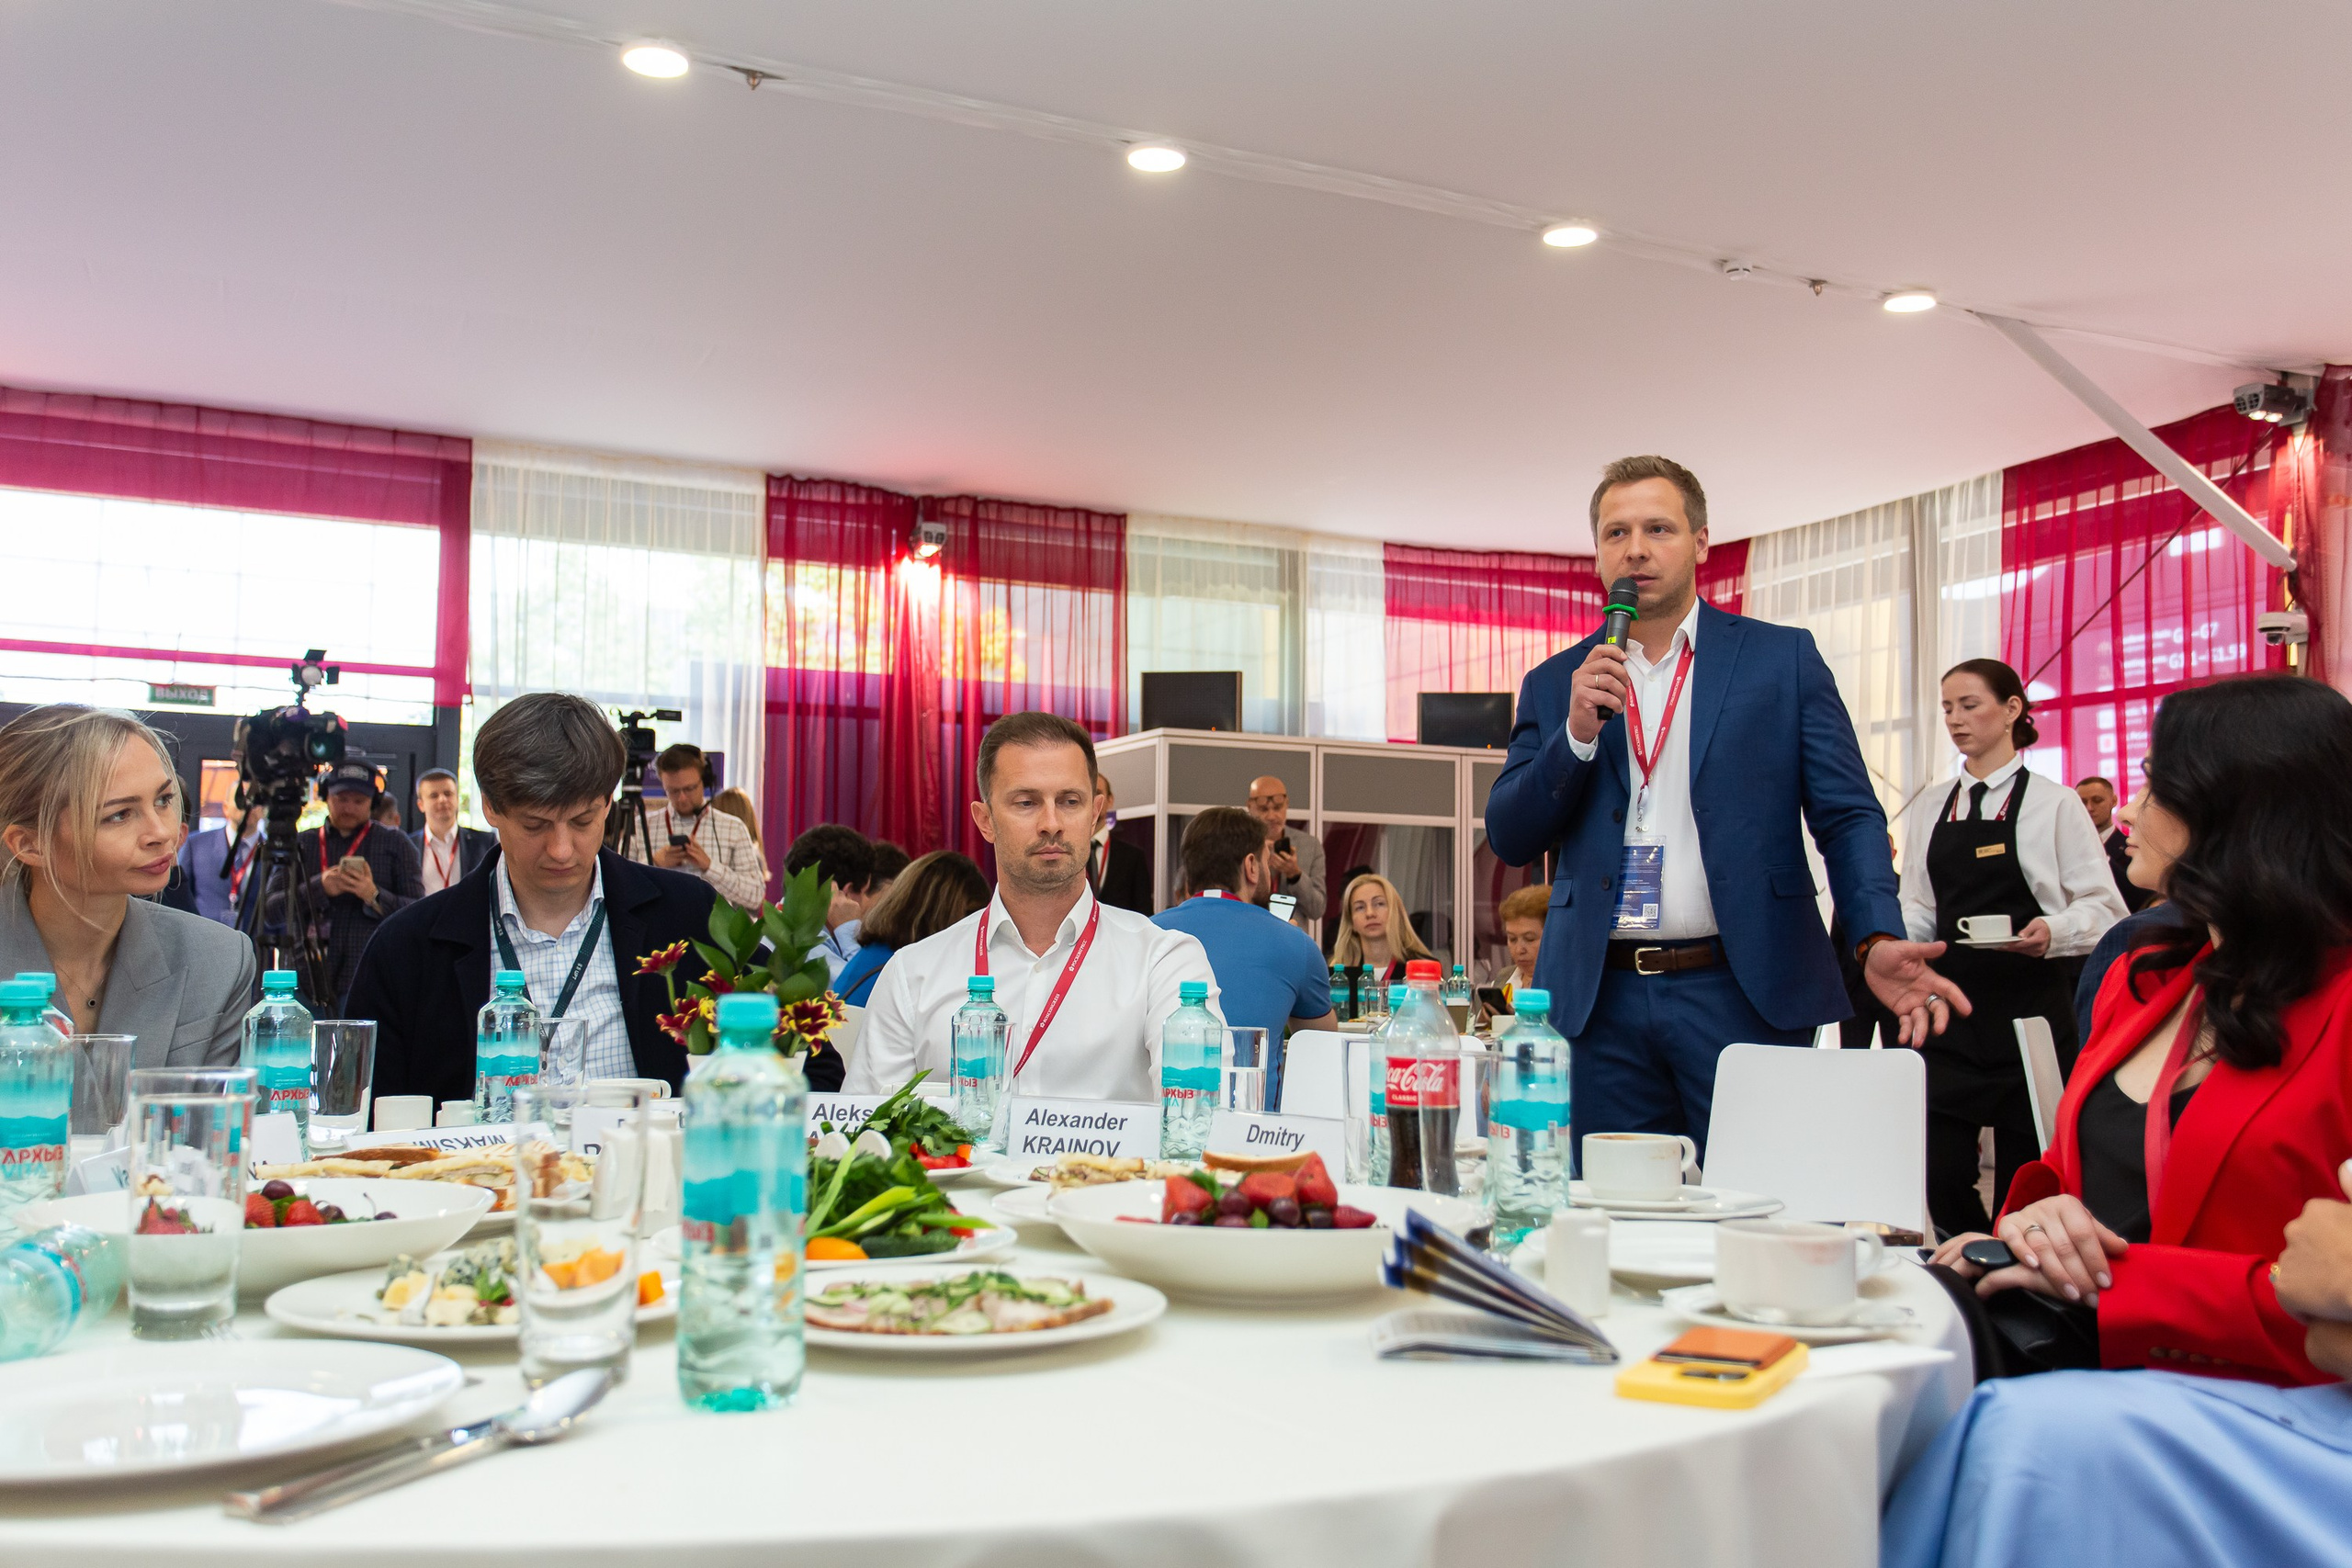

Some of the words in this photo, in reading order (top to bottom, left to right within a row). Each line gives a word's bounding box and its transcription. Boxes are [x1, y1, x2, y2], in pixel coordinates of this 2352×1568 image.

[1385, 1062, 1446, 1092] ca-Cola
[811, 1103, 873, 1122] Aleks
[1024, 1108, 1128, 1131] Alexander
[1022, 1134, 1121, 1157] KRAINOV
[1246, 1123, 1306, 1153] Dmitry
